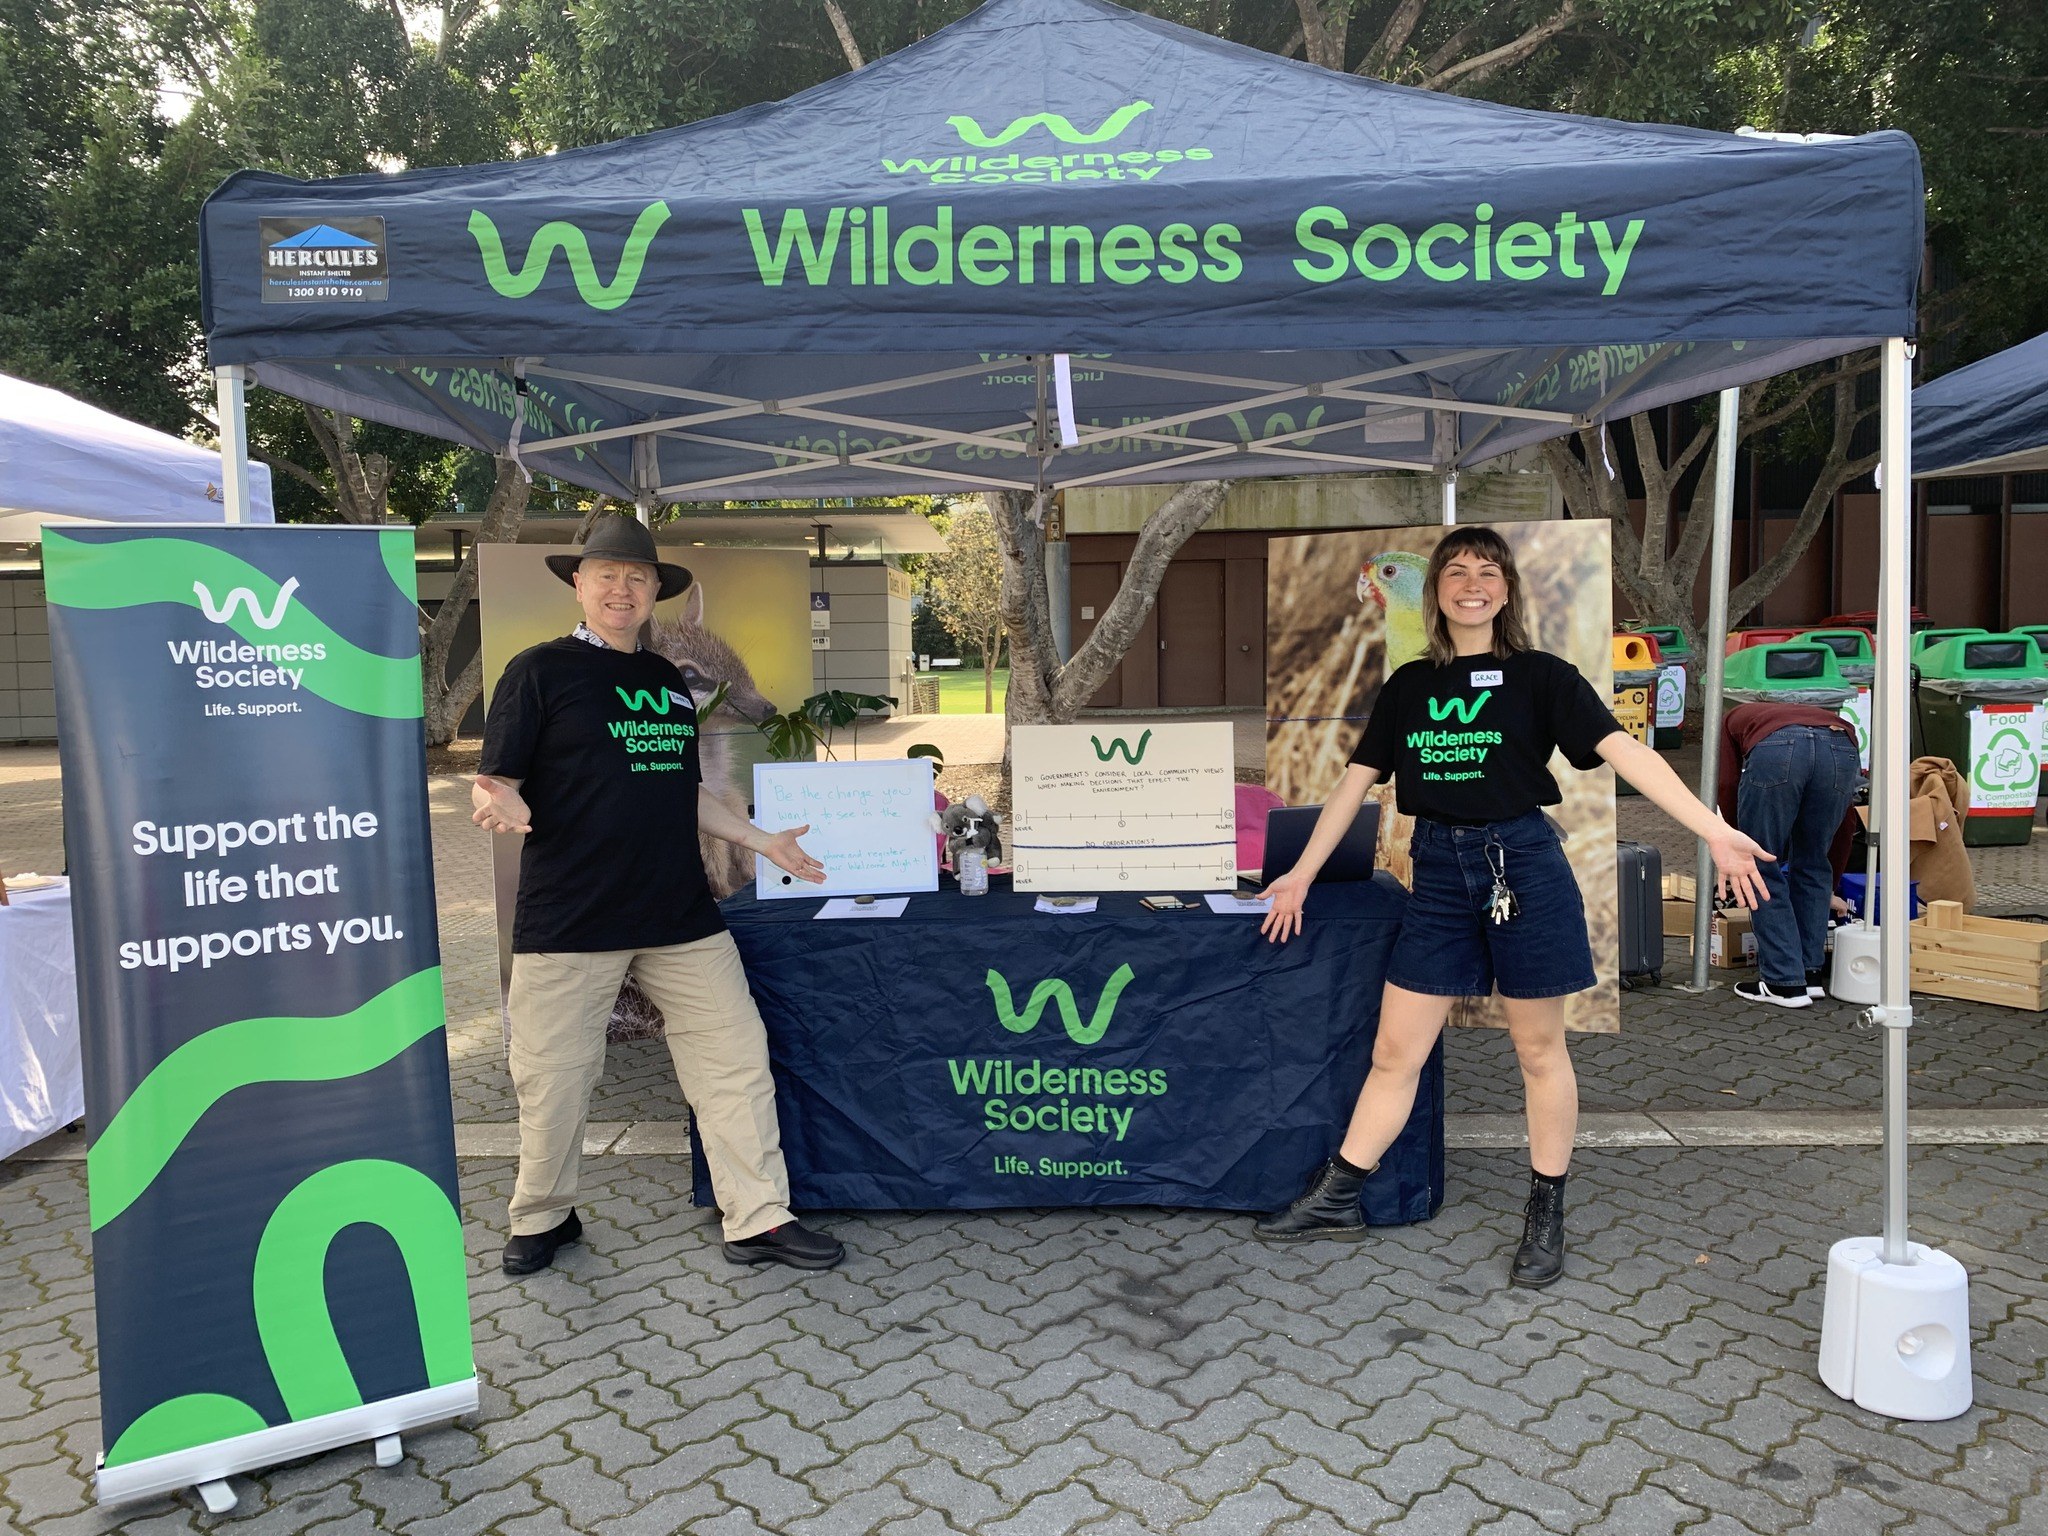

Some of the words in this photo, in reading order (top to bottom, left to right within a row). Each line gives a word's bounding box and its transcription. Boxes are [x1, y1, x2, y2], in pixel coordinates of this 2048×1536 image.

[881, 147, 1214, 174] Wilderness
[929, 165, 1164, 186] Society
[268, 249, 379, 267] HERCULES
[741, 205, 1243, 286] Wilderness
[1293, 202, 1646, 296] Society
[269, 278, 382, 286] herculesinstantshelter.com.au
[288, 287, 315, 297] 1300
[317, 287, 338, 297] 810
[341, 287, 363, 297] 910
[167, 640, 327, 665] Wilderness
[195, 665, 304, 690] Society
[1475, 673, 1499, 682] GRACE
[1663, 668, 1678, 677] ood
[204, 703, 235, 717] Life.
[238, 701, 302, 717] Support.
[1989, 712, 2027, 727] Food
[607, 720, 695, 738] Wilderness
[625, 736, 685, 755] Society
[1407, 730, 1502, 748] Wilderness
[1420, 746, 1488, 764] Society
[631, 762, 649, 772] Life.
[650, 761, 684, 772] Support.
[1024, 775, 1034, 783] DO
[1040, 771, 1090, 781] GOVERNMENTS
[1094, 770, 1127, 778] CONSIDER
[1133, 770, 1154, 778] LOCAL
[1159, 768, 1199, 776] COMMUNITY
[1203, 767, 1225, 775] VIEWS
[1089, 778, 1123, 786] DECISIONS
[1423, 771, 1443, 781] Life.
[1444, 771, 1485, 782] Support.
[801, 785, 821, 801] the
[827, 785, 873, 806] change
[882, 786, 912, 806] you
[778, 808, 810, 821] want
[821, 807, 832, 820] to
[836, 811, 855, 820] see
[862, 809, 873, 818] in
[880, 807, 903, 818] the
[132, 812, 307, 860] Support
[314, 805, 378, 840] the
[1085, 840, 1096, 848] DO
[1102, 838, 1155, 847] CORPORATIONS?
[184, 868, 248, 908] life
[255, 863, 339, 901] that
[119, 920, 312, 973] supports
[318, 914, 404, 955] you.
[947, 1059, 1168, 1096] Wilderness
[984, 1098, 1134, 1142] Society
[993, 1156, 1035, 1176] Life.
[1038, 1157, 1129, 1179] Support.
